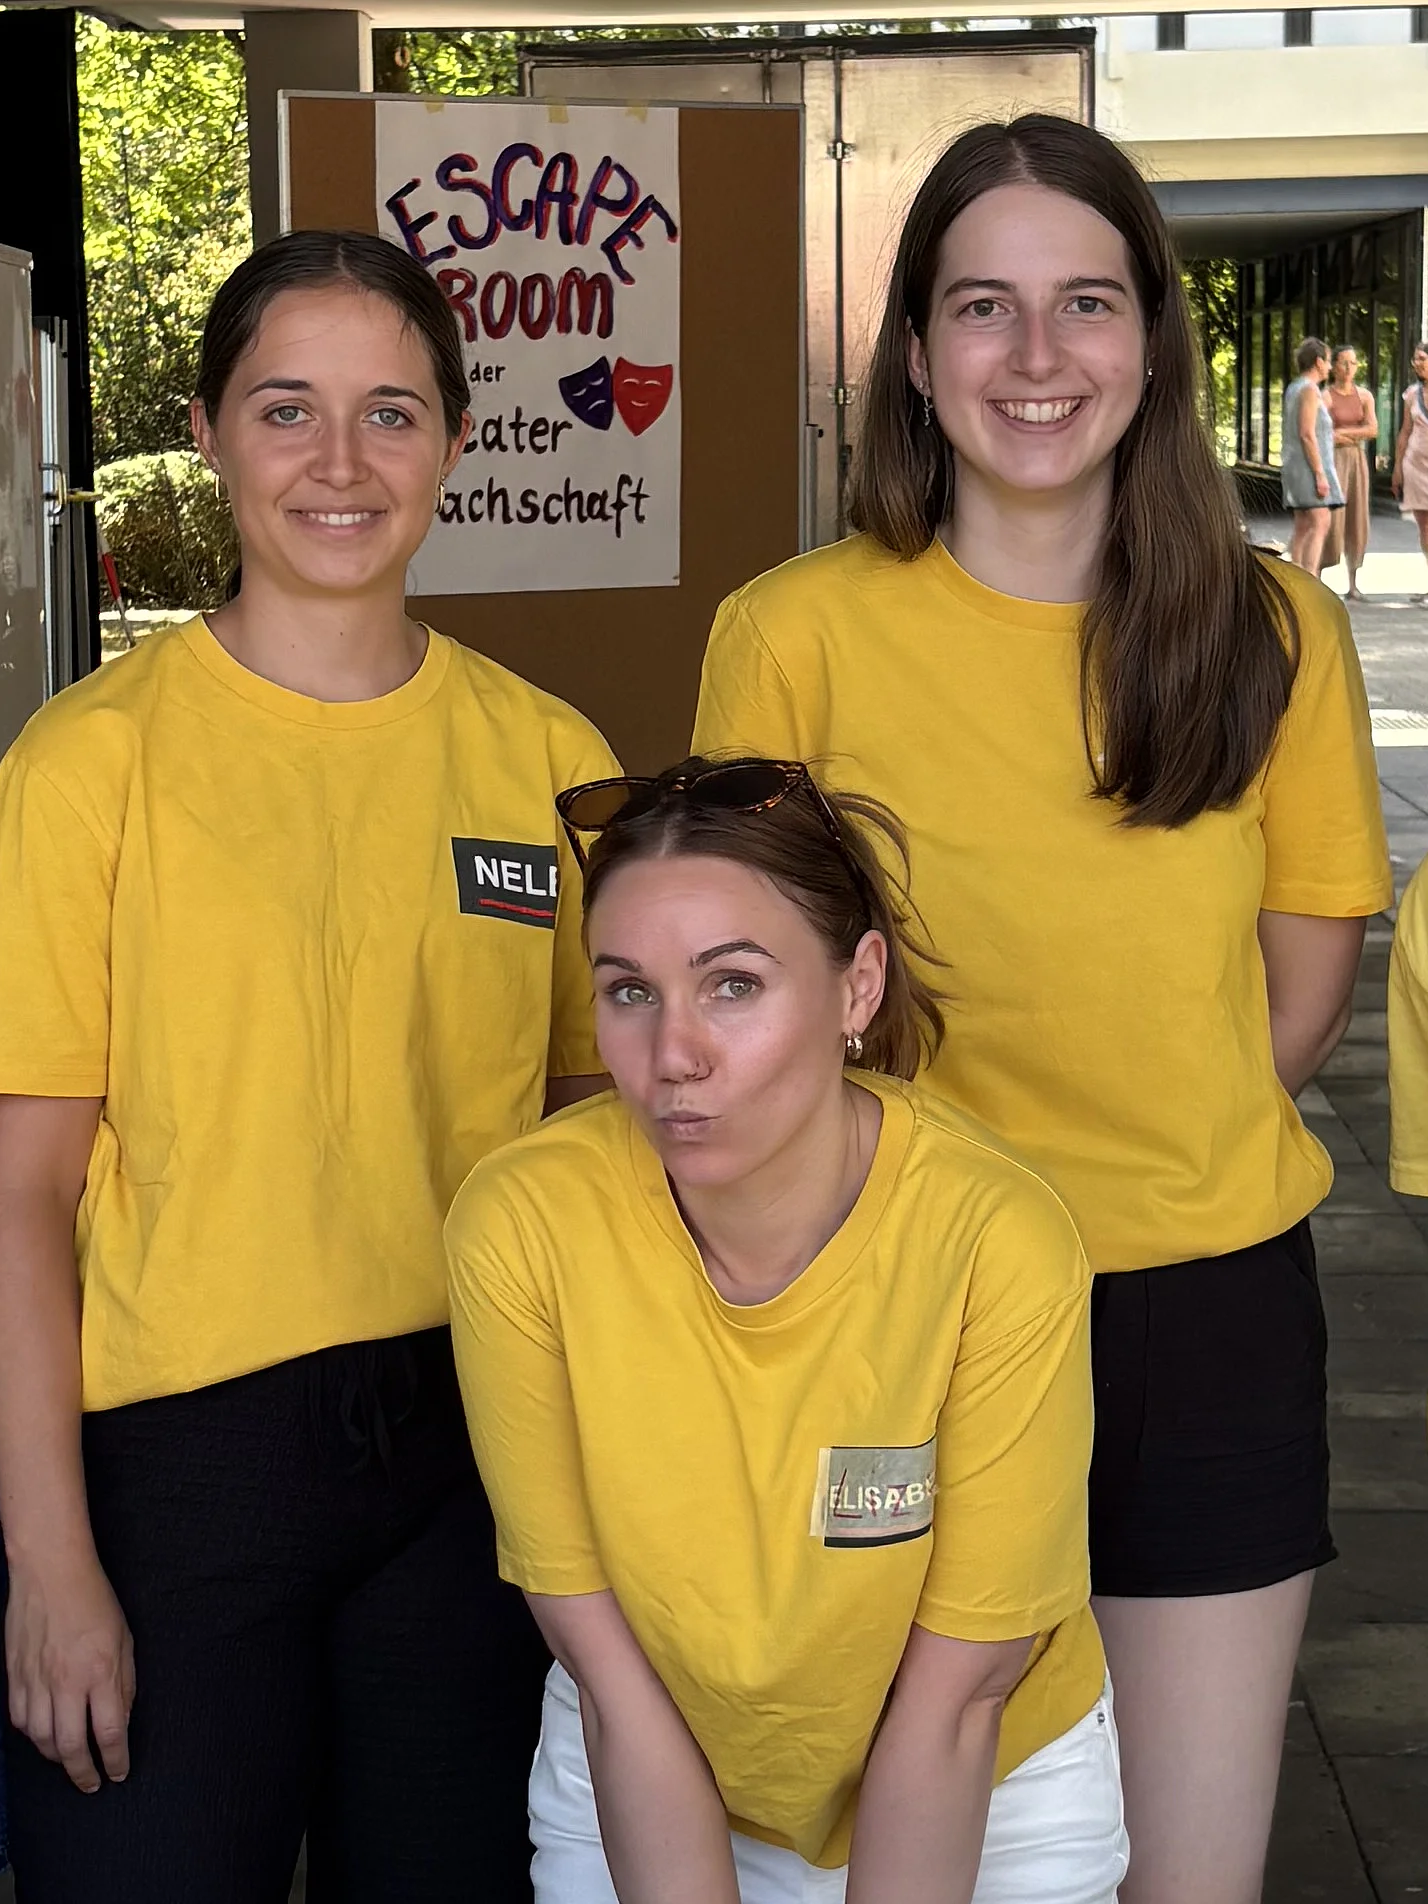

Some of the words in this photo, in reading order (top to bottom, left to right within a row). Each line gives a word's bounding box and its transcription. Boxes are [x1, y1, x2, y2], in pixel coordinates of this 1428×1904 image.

[386, 142, 678, 285] ESCAPE
[470, 361, 507, 383] der
[463, 406, 573, 454] ater
[438, 474, 651, 538] achschaft
